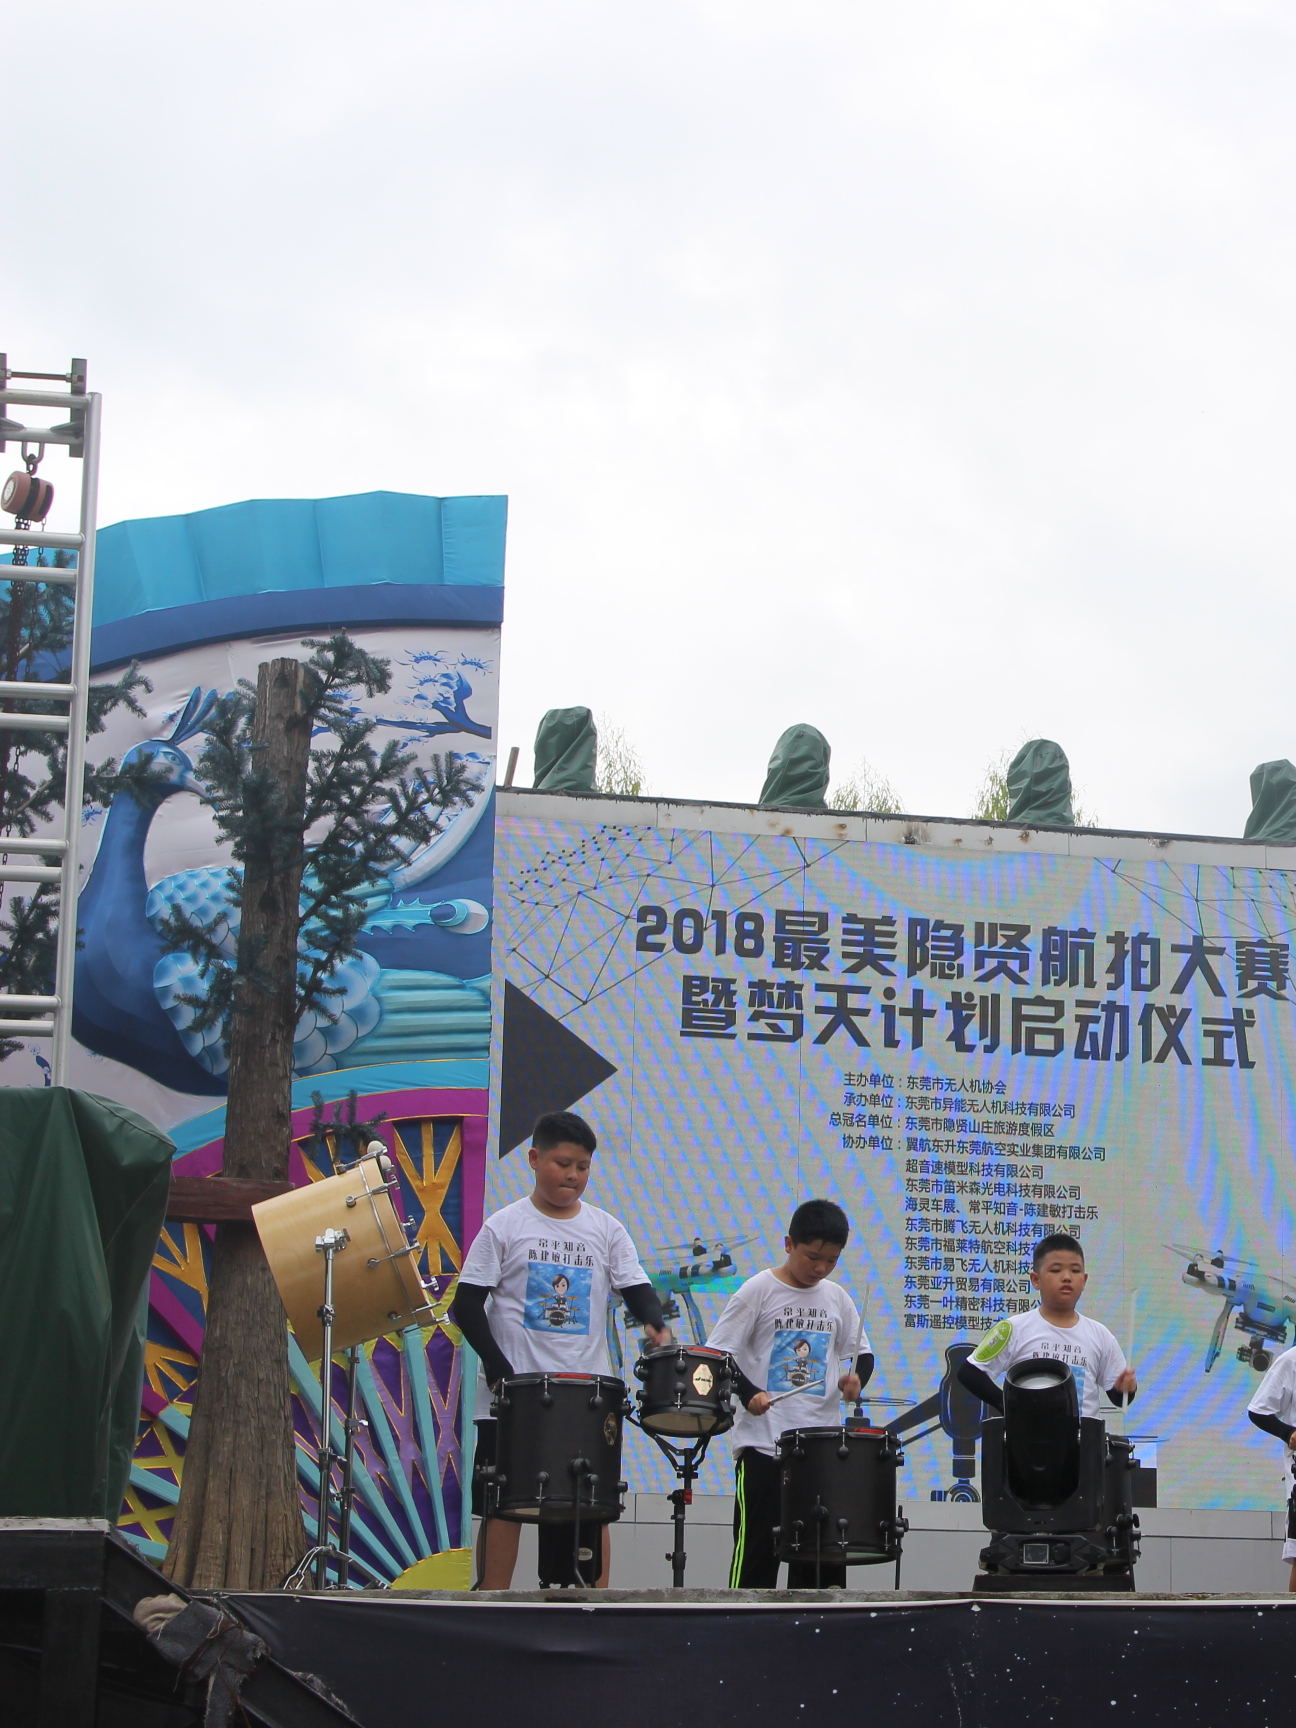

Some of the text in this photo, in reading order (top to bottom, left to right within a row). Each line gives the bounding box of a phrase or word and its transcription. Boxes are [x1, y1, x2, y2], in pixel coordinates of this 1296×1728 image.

[636, 904, 1291, 1001] 2018最美隐贤航拍大赛
[680, 974, 1257, 1070] 暨梦天计划启动仪式
[905, 1159, 1043, 1179] 超音速模型科技有限公司
[905, 1178, 1080, 1200] 东莞市笛米森光电科技有限公司
[904, 1275, 1031, 1294] 东莞亚升贸易有限公司
